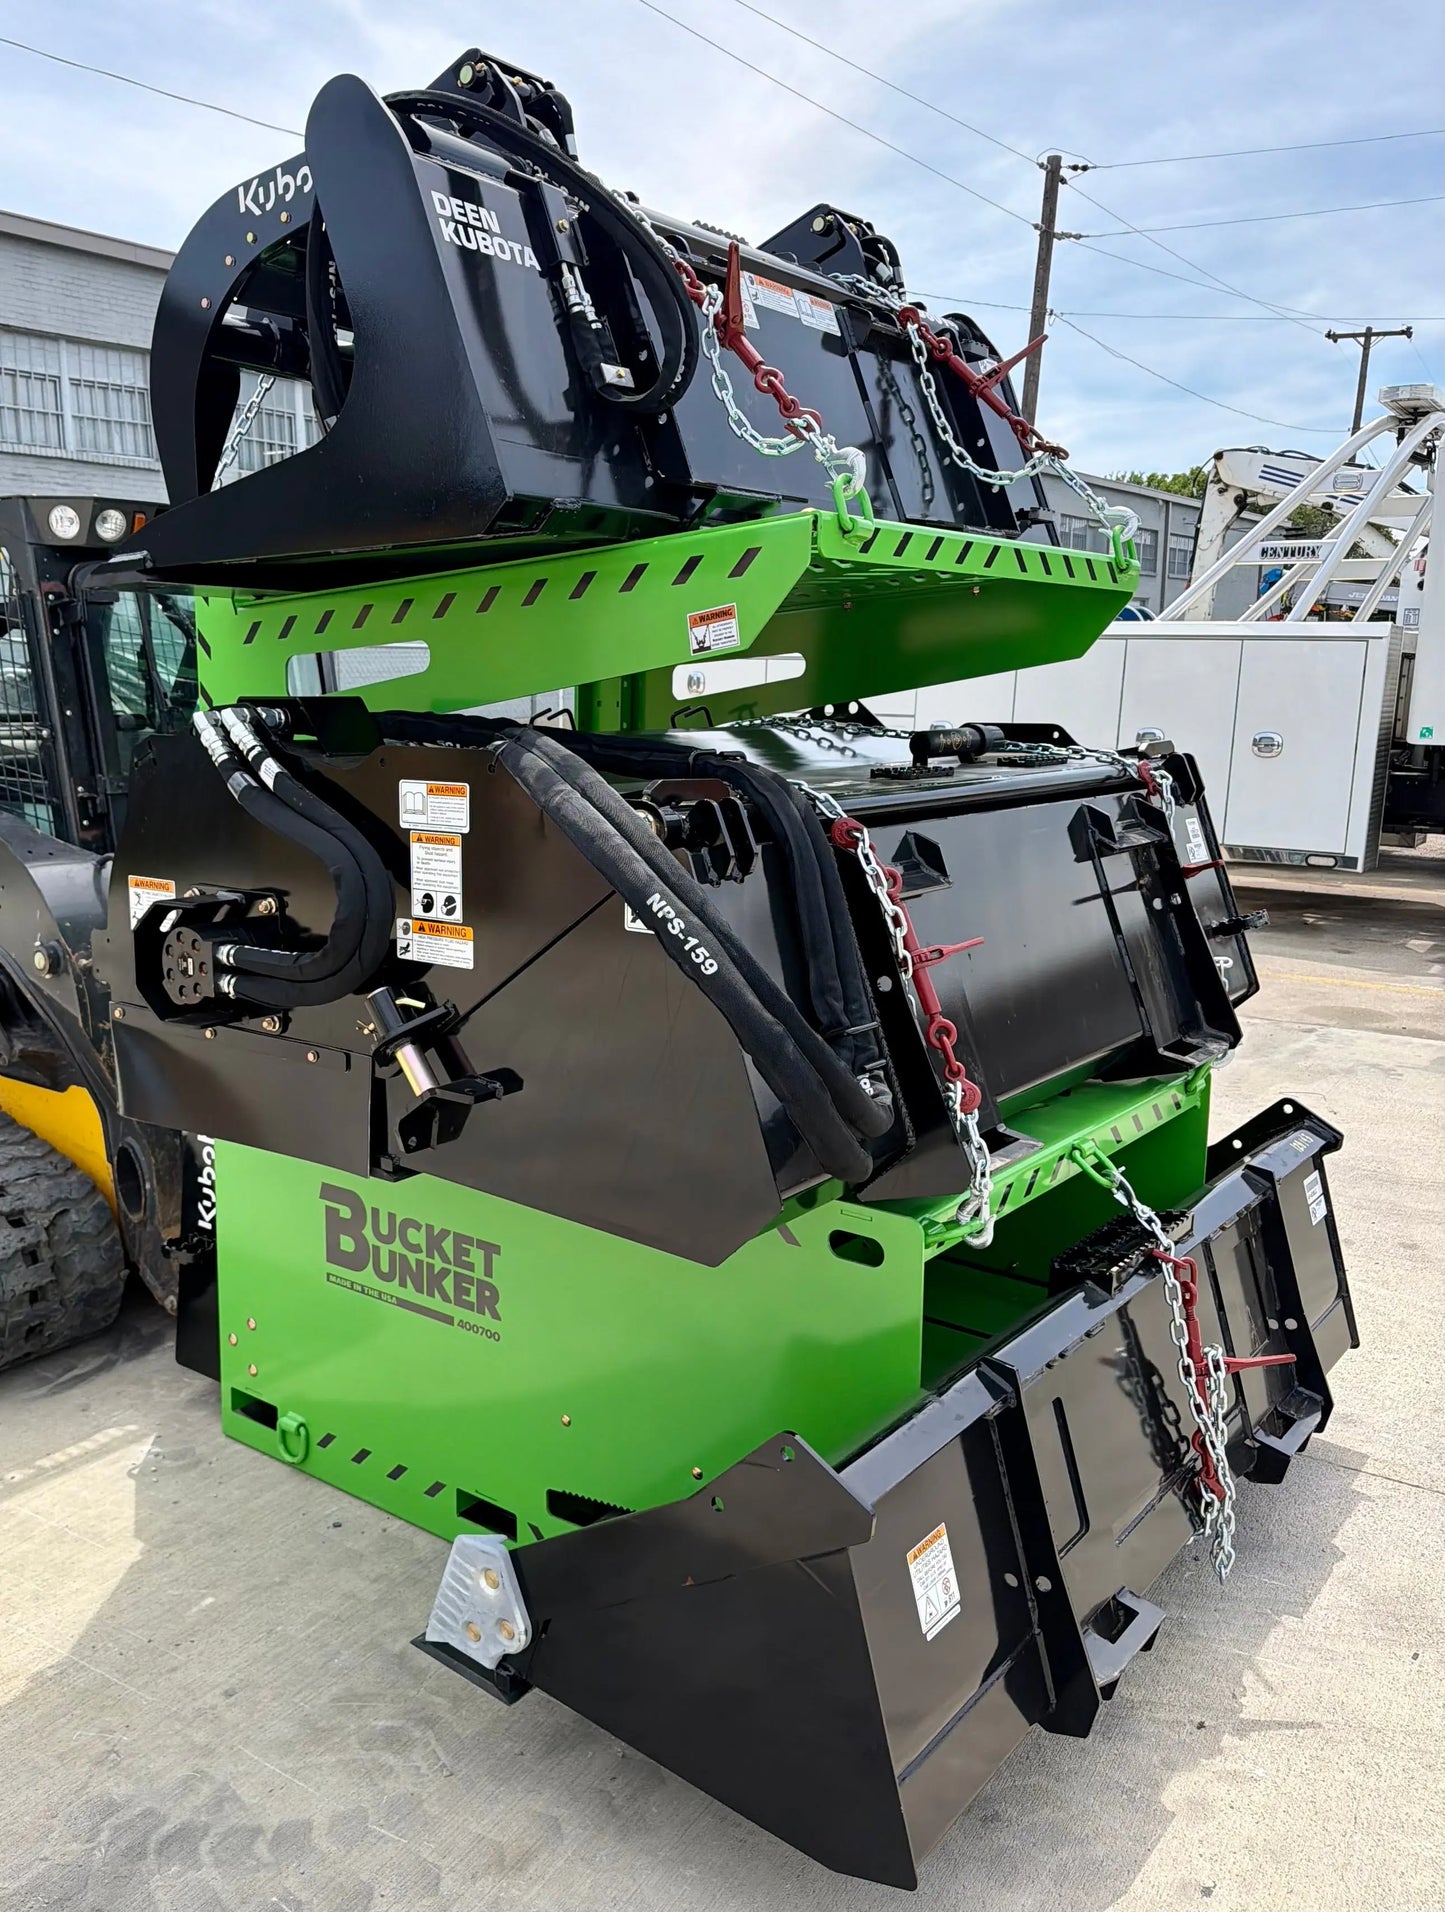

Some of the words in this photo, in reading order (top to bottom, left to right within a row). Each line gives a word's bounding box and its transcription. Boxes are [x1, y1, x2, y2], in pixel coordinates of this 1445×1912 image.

[431, 190, 501, 234] DEEN
[438, 217, 542, 271] KUBOTA
[1260, 545, 1322, 559] CENTURY
[698, 609, 732, 623] WARNING
[435, 786, 465, 795] WARNING
[425, 835, 455, 845] WARNING
[140, 880, 169, 891] WARNING
[428, 924, 467, 938] WARNING
[646, 892, 719, 975] NPS-159
[319, 1182, 502, 1278] BUCKET
[328, 1274, 352, 1288] MADE
[353, 1283, 362, 1292] IN
[363, 1286, 380, 1297] THE
[381, 1292, 397, 1304] USA
[457, 1319, 501, 1342] 400700
[917, 1529, 942, 1555] WARNING
